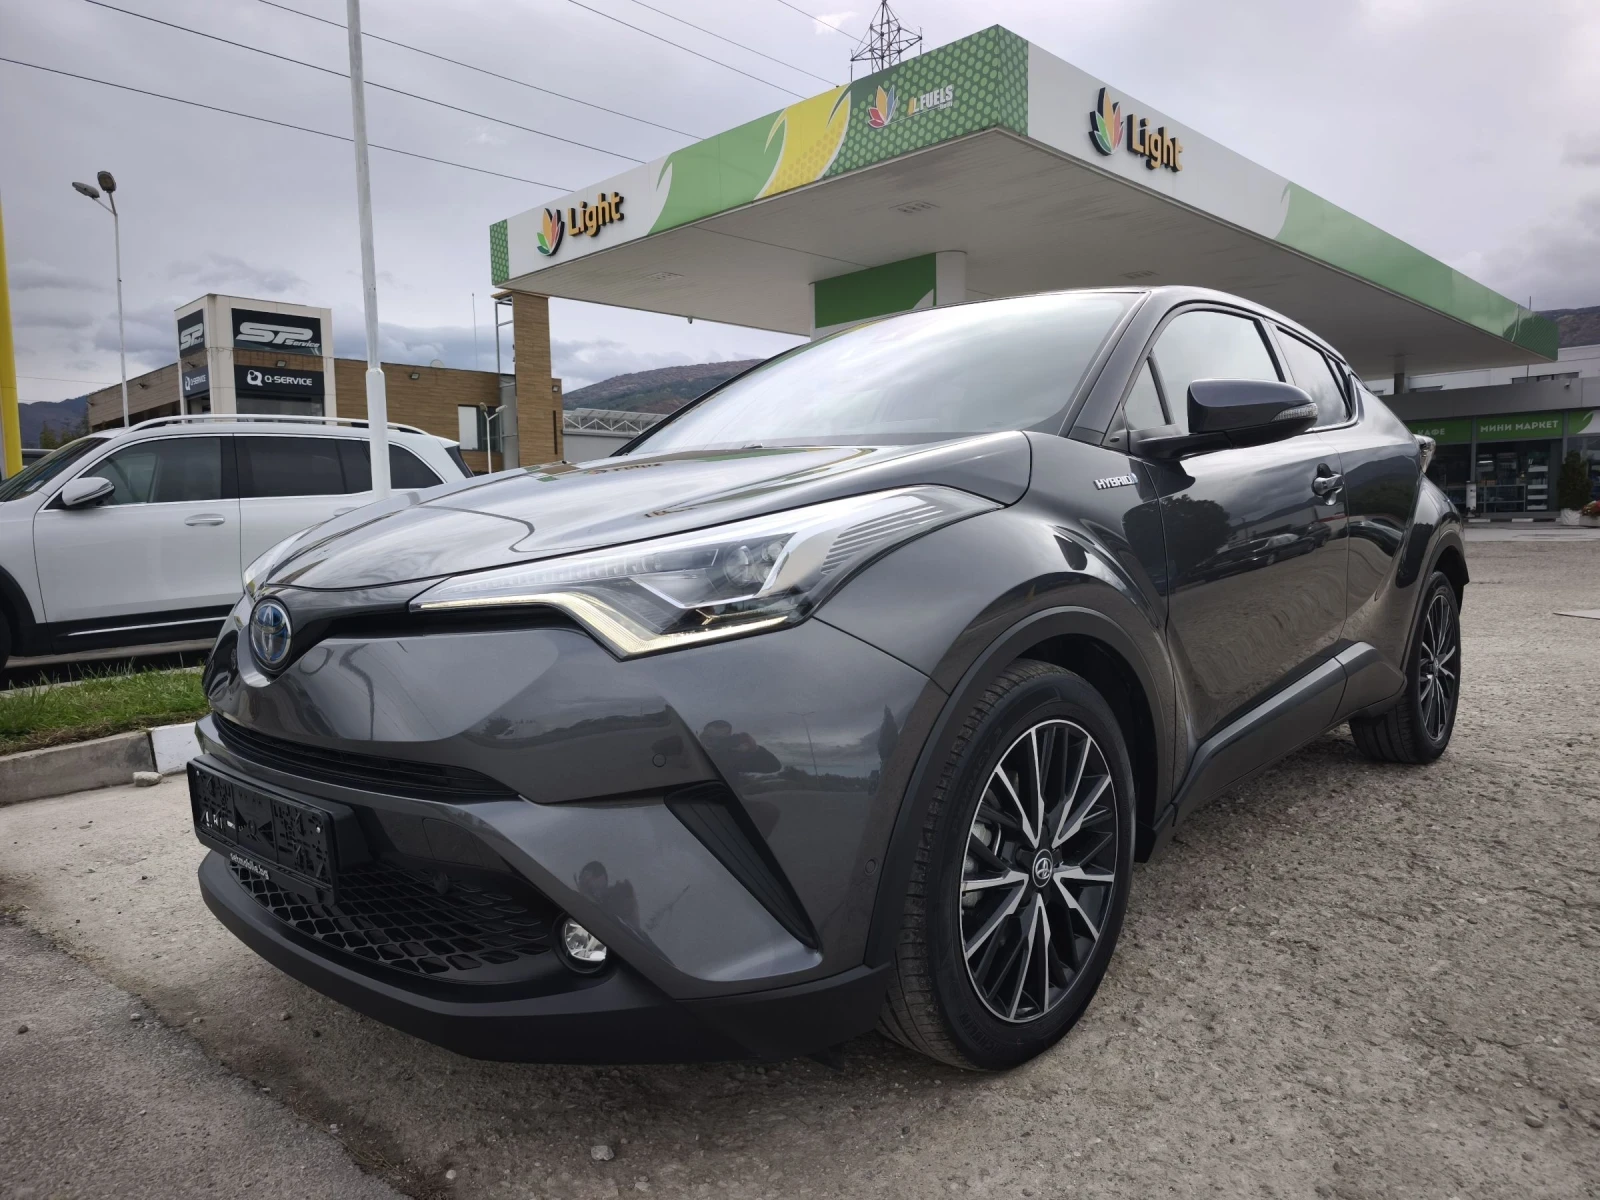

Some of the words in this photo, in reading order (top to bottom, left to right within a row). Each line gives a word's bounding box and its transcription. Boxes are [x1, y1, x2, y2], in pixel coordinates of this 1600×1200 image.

[920, 84, 954, 111] FUELS
[1127, 113, 1184, 171] Light
[567, 191, 624, 238] Light
[180, 322, 203, 350] SP
[235, 321, 313, 344] SP
[284, 338, 320, 348] Service
[264, 375, 313, 386] Q-SERVICE
[1480, 423, 1512, 433] МИНИ
[1515, 420, 1559, 431] МАРКЕТ
[1094, 475, 1133, 489] HYBRID
